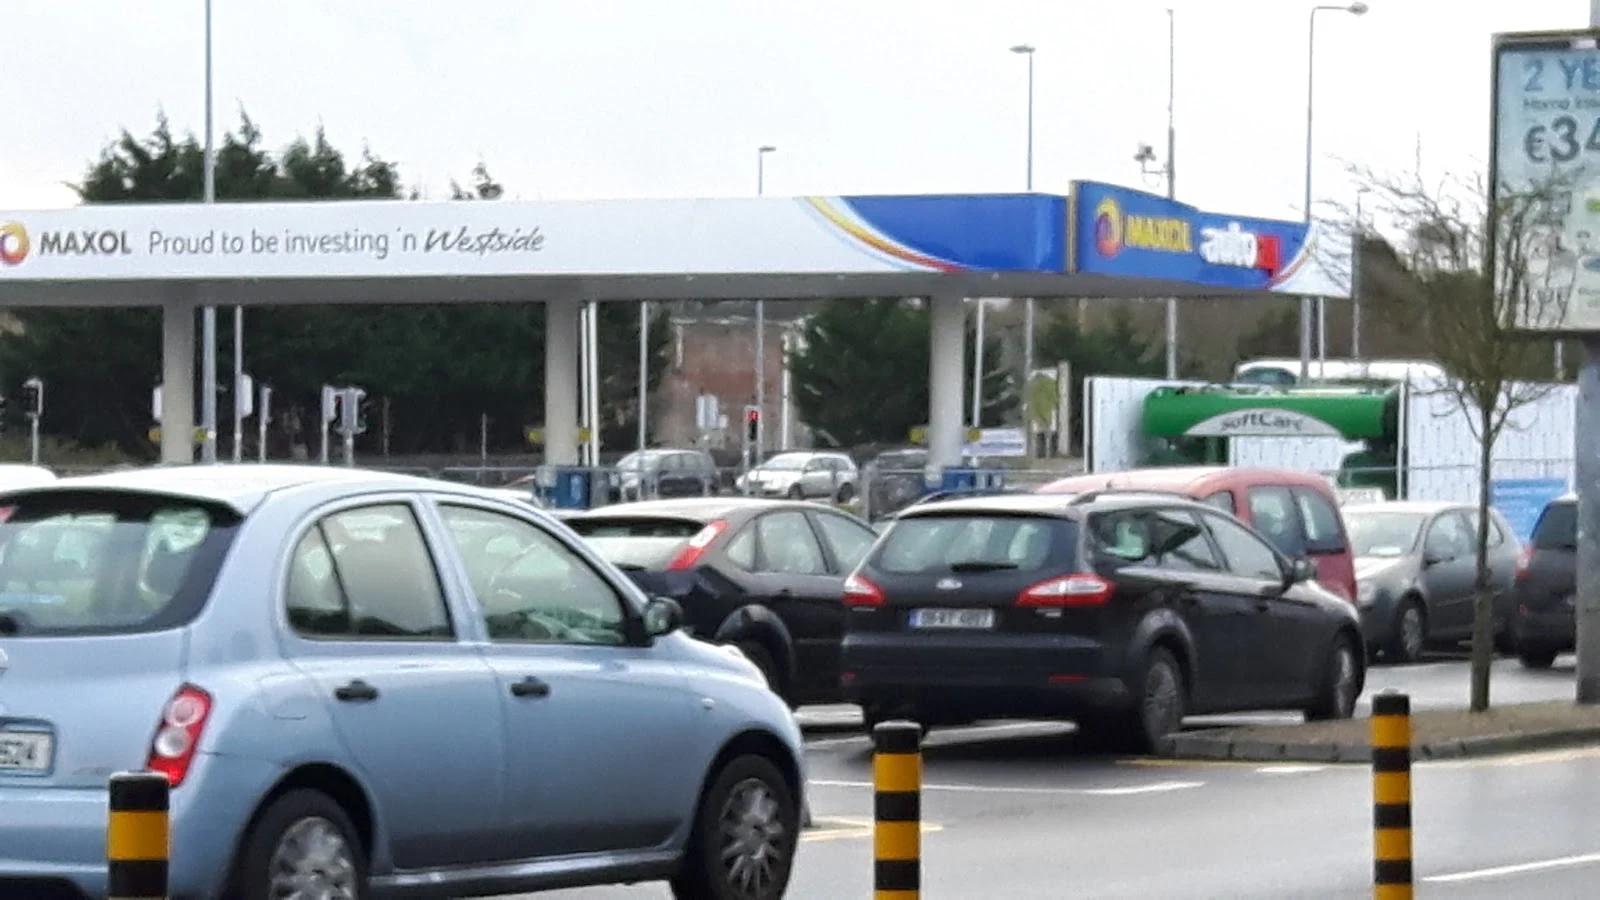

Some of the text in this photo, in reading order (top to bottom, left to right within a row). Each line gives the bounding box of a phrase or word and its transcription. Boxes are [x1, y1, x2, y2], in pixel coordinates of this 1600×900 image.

[1522, 58, 1544, 92] 2
[39, 230, 132, 255] MAXOL
[149, 229, 214, 254] Proud
[222, 232, 244, 253] to
[251, 228, 278, 253] be
[285, 228, 389, 260] investing
[424, 225, 544, 256] Westside
